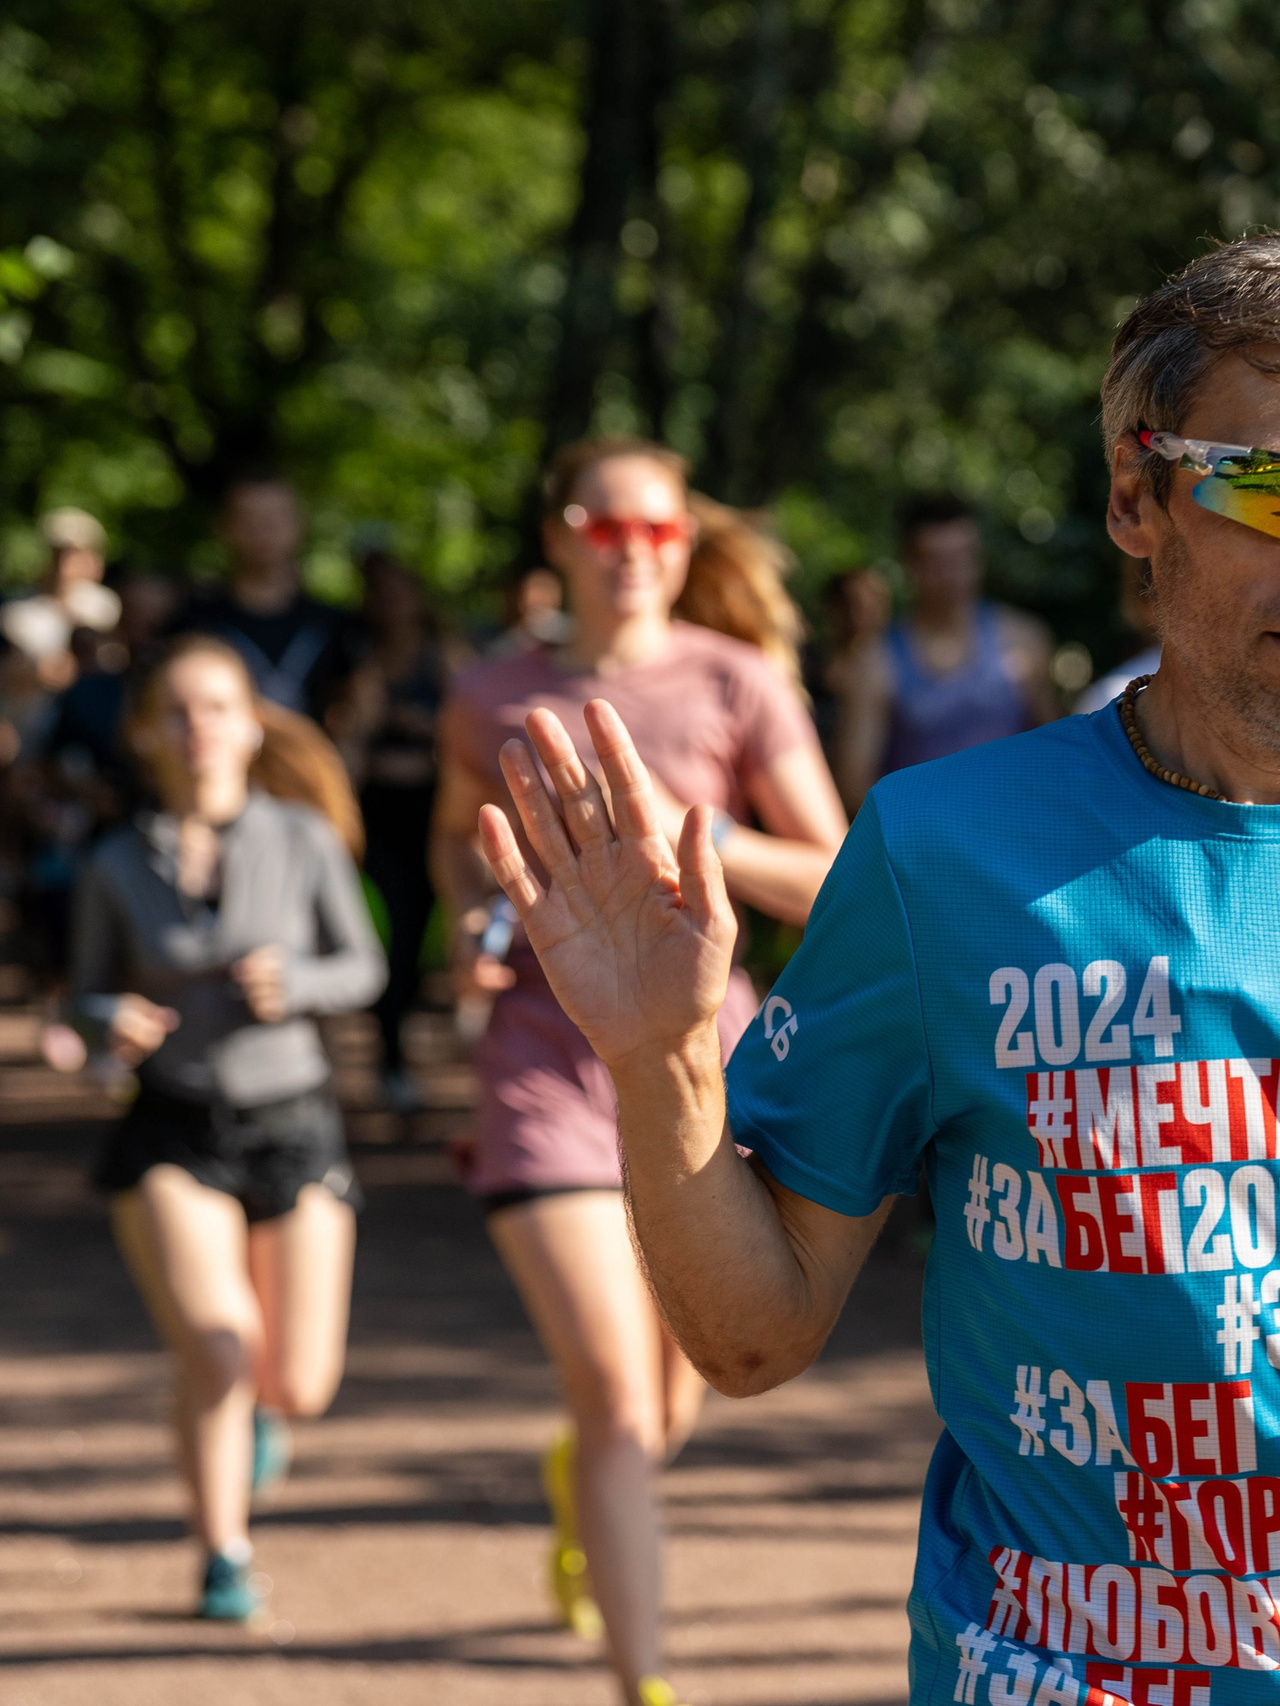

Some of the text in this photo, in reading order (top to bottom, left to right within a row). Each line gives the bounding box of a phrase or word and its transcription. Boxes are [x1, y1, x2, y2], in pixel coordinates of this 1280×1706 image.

[756, 991, 799, 1062] СБ
[989, 956, 1181, 1068] 2024
[1010, 1365, 1252, 1478] #ЗАБЕГ
